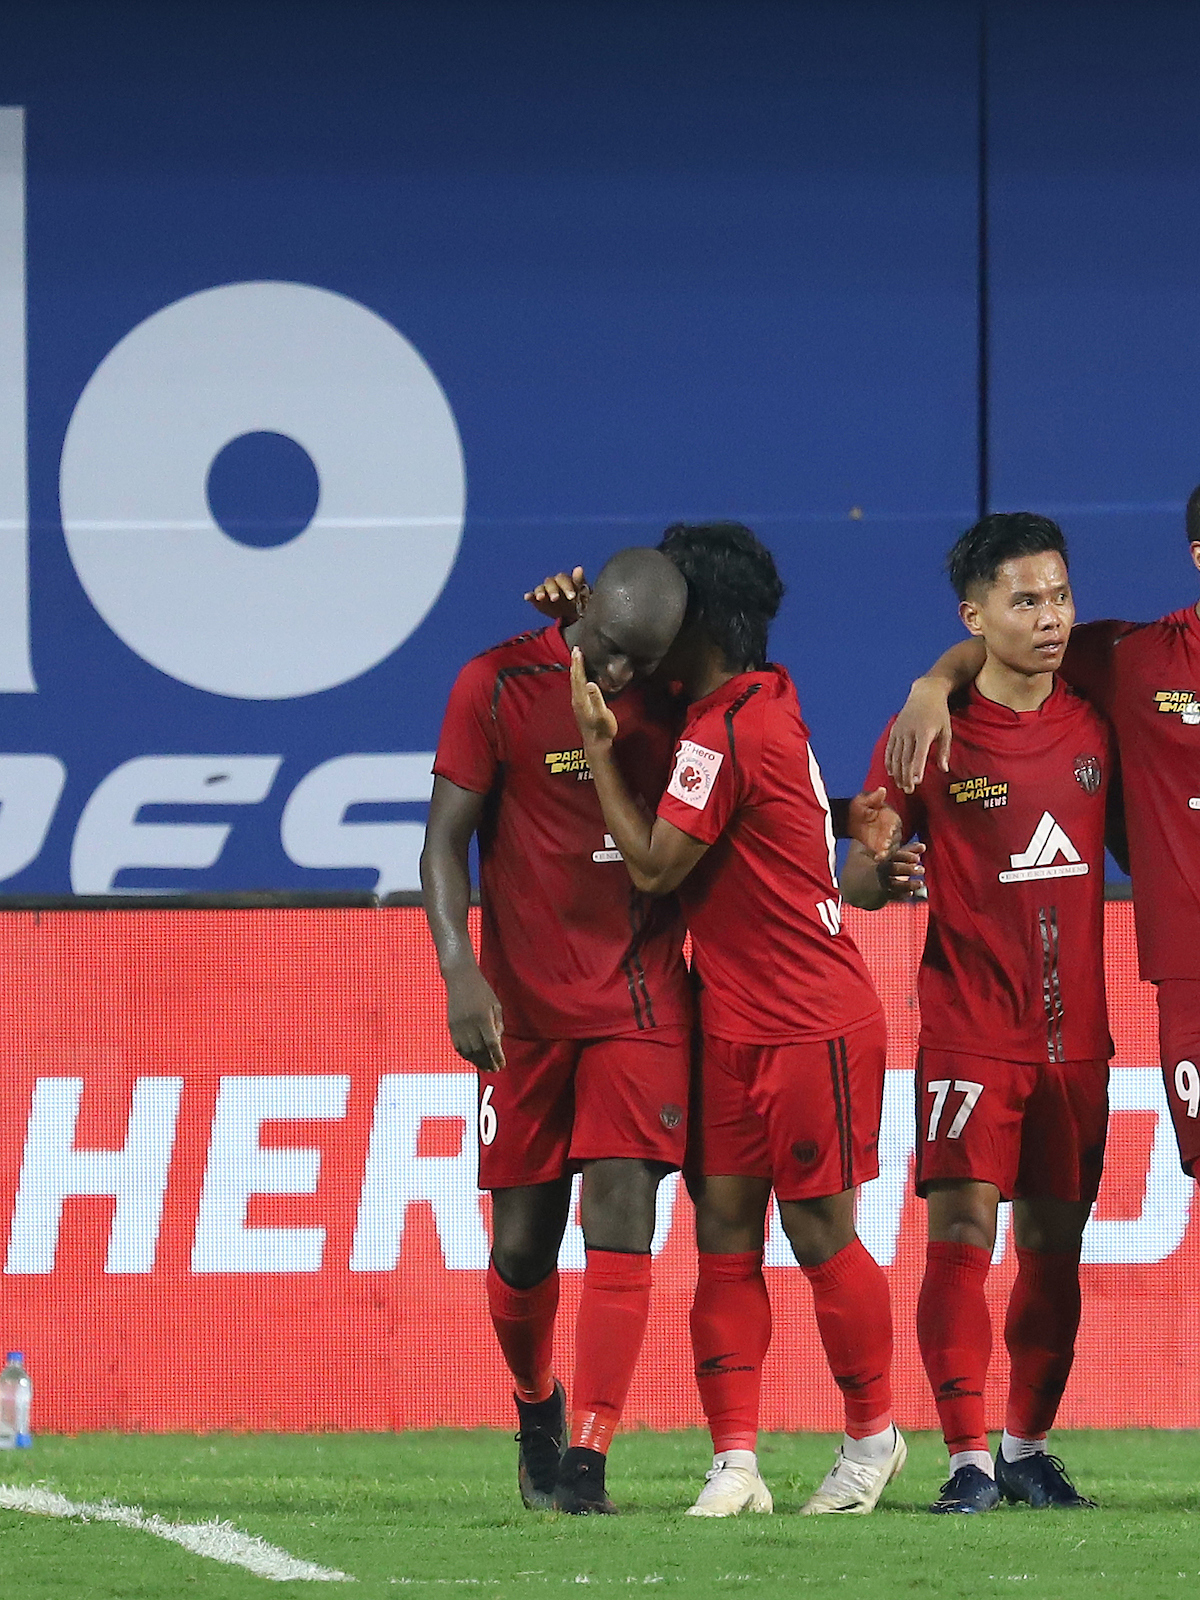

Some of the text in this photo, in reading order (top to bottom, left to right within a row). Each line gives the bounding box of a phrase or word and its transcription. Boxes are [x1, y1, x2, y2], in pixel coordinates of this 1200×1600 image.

[0, 106, 466, 700] o
[1155, 691, 1193, 703] PARI
[545, 749, 583, 764] PARI
[691, 746, 716, 761] Hero
[551, 760, 590, 774] MAT
[949, 776, 988, 795] PARI
[956, 782, 1008, 804] MATCH
[983, 796, 1007, 810] NEWS
[1174, 1060, 1200, 1118] 9
[927, 1079, 985, 1142] 77
